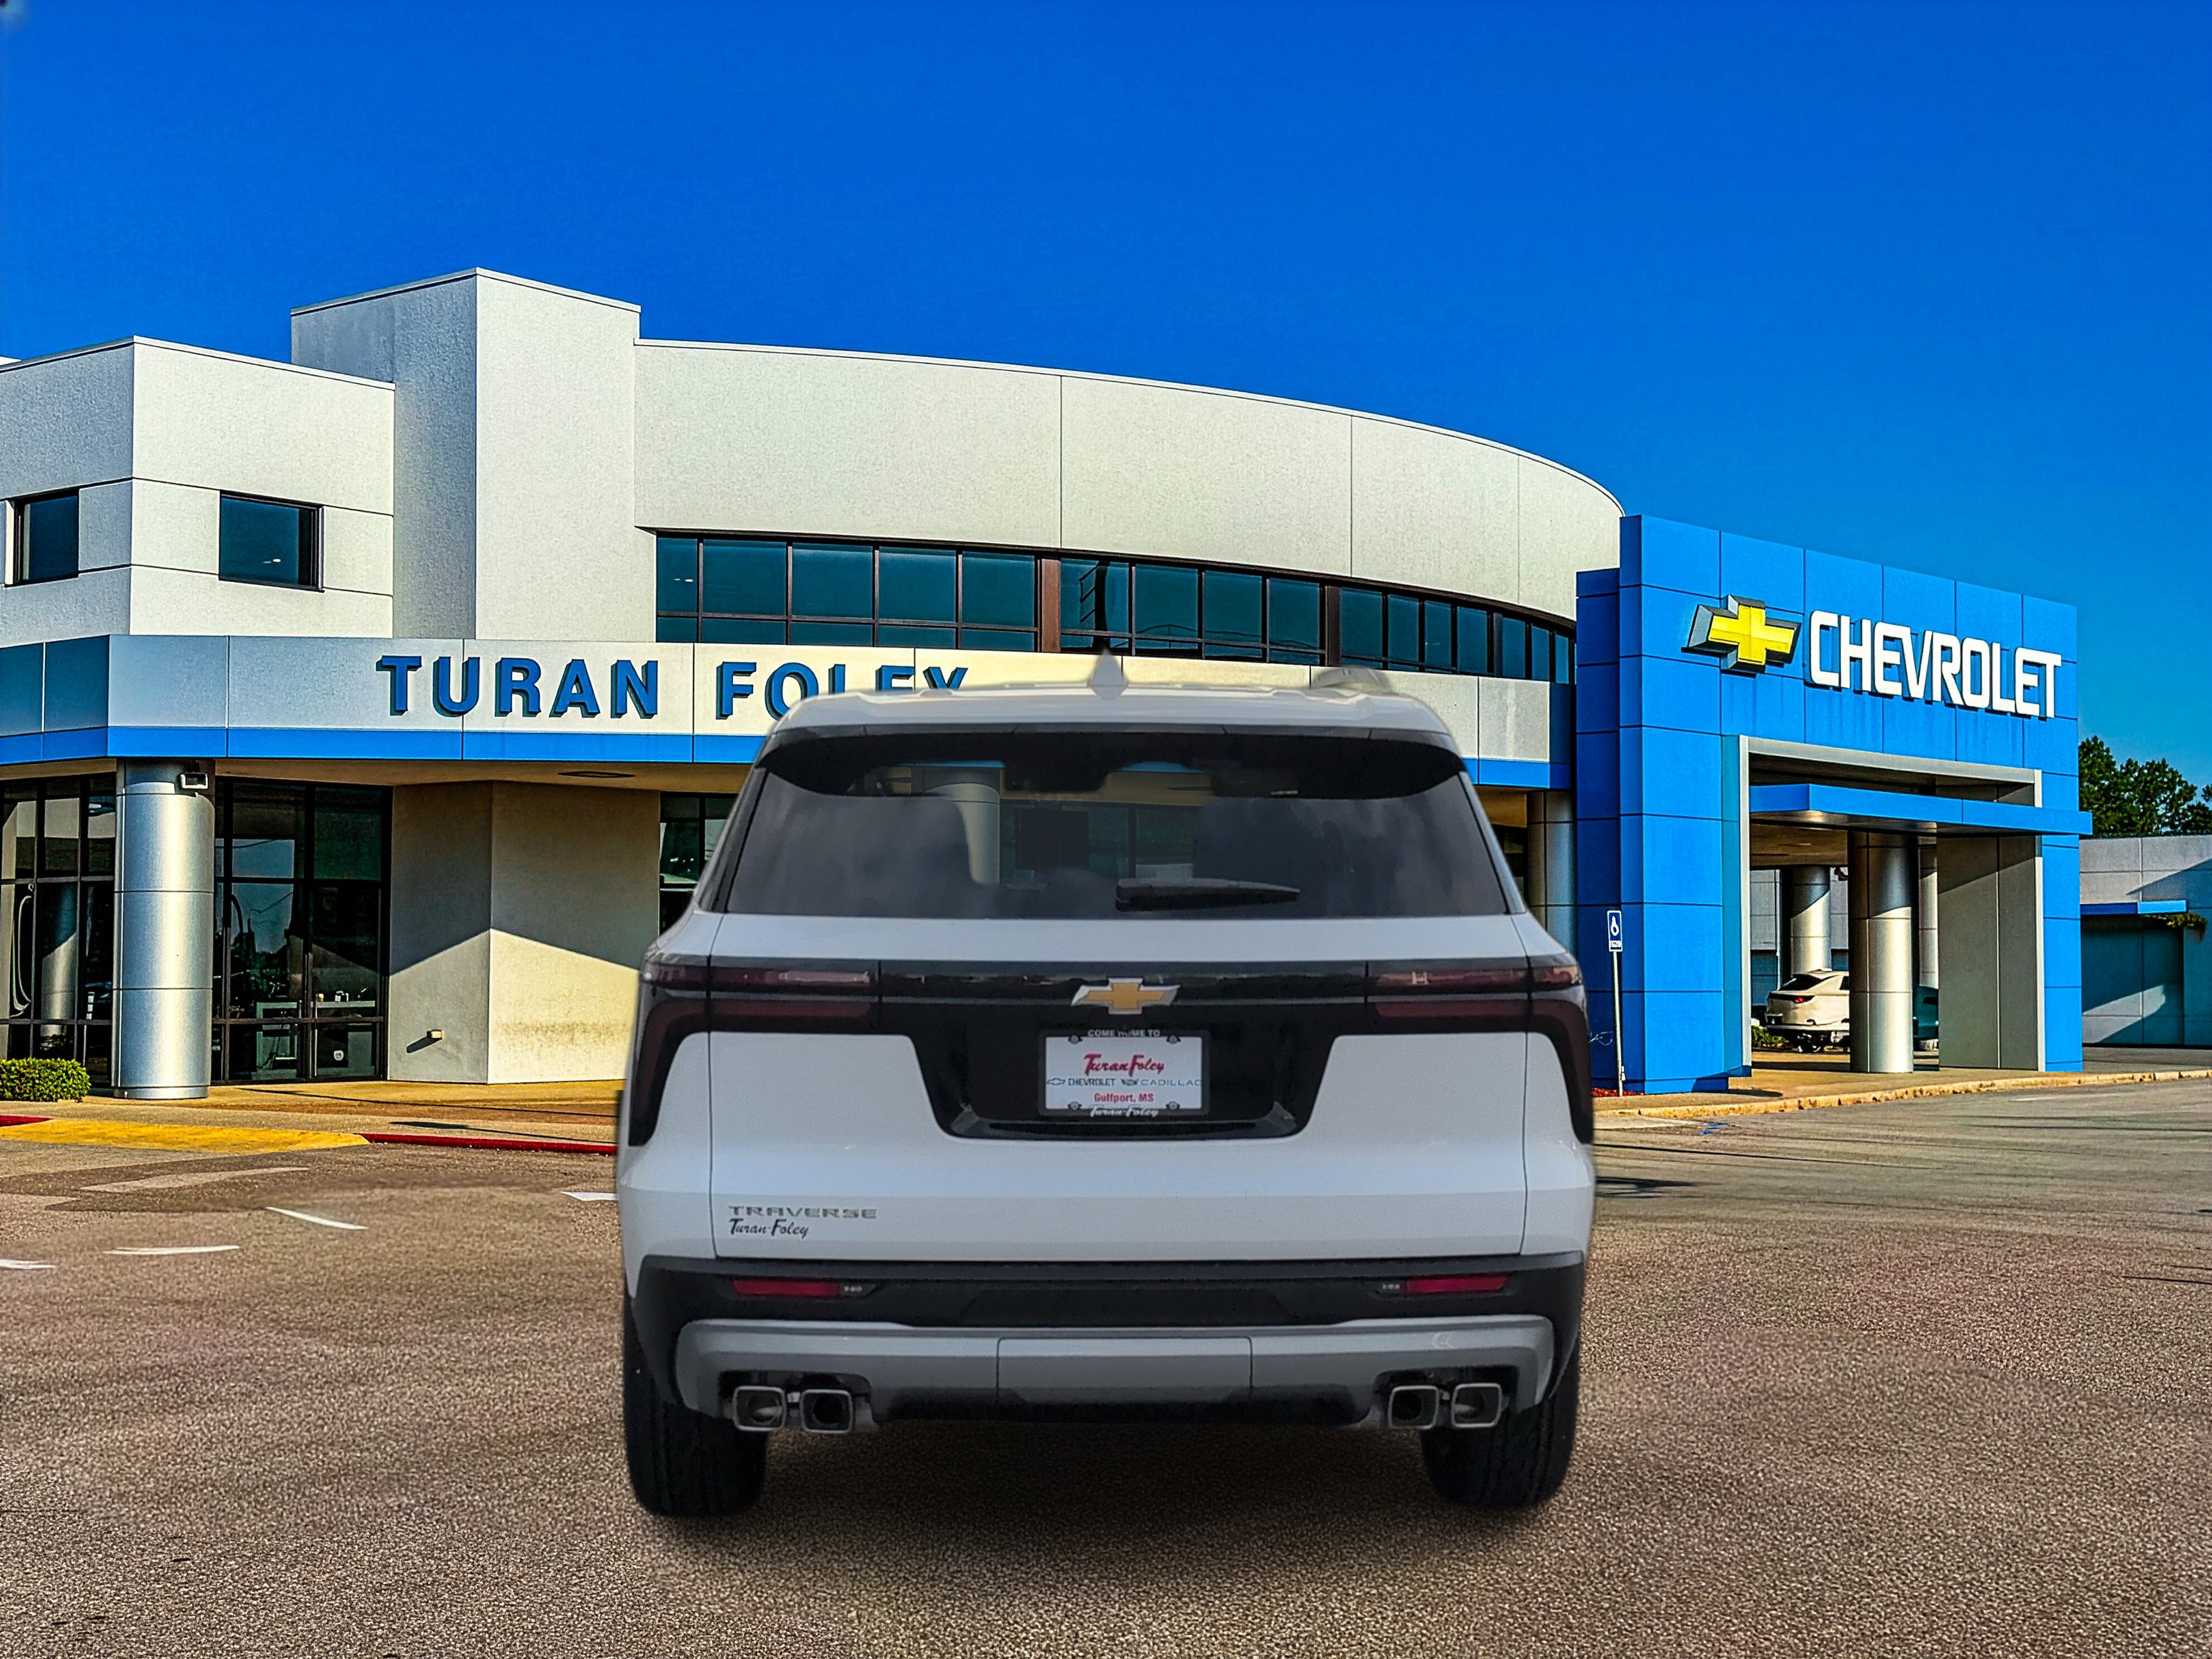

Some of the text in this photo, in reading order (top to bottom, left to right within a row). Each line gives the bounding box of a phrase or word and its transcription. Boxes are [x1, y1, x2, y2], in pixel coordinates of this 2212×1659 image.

[1811, 610, 2062, 718] CHEVROLET
[376, 655, 658, 719] TURAN
[1128, 1054, 1165, 1077] Foley
[1068, 1078, 1116, 1086] CHEVROLET
[1094, 1093, 1154, 1103] Gulfport, MS
[729, 1205, 877, 1219] TRAVERSE
